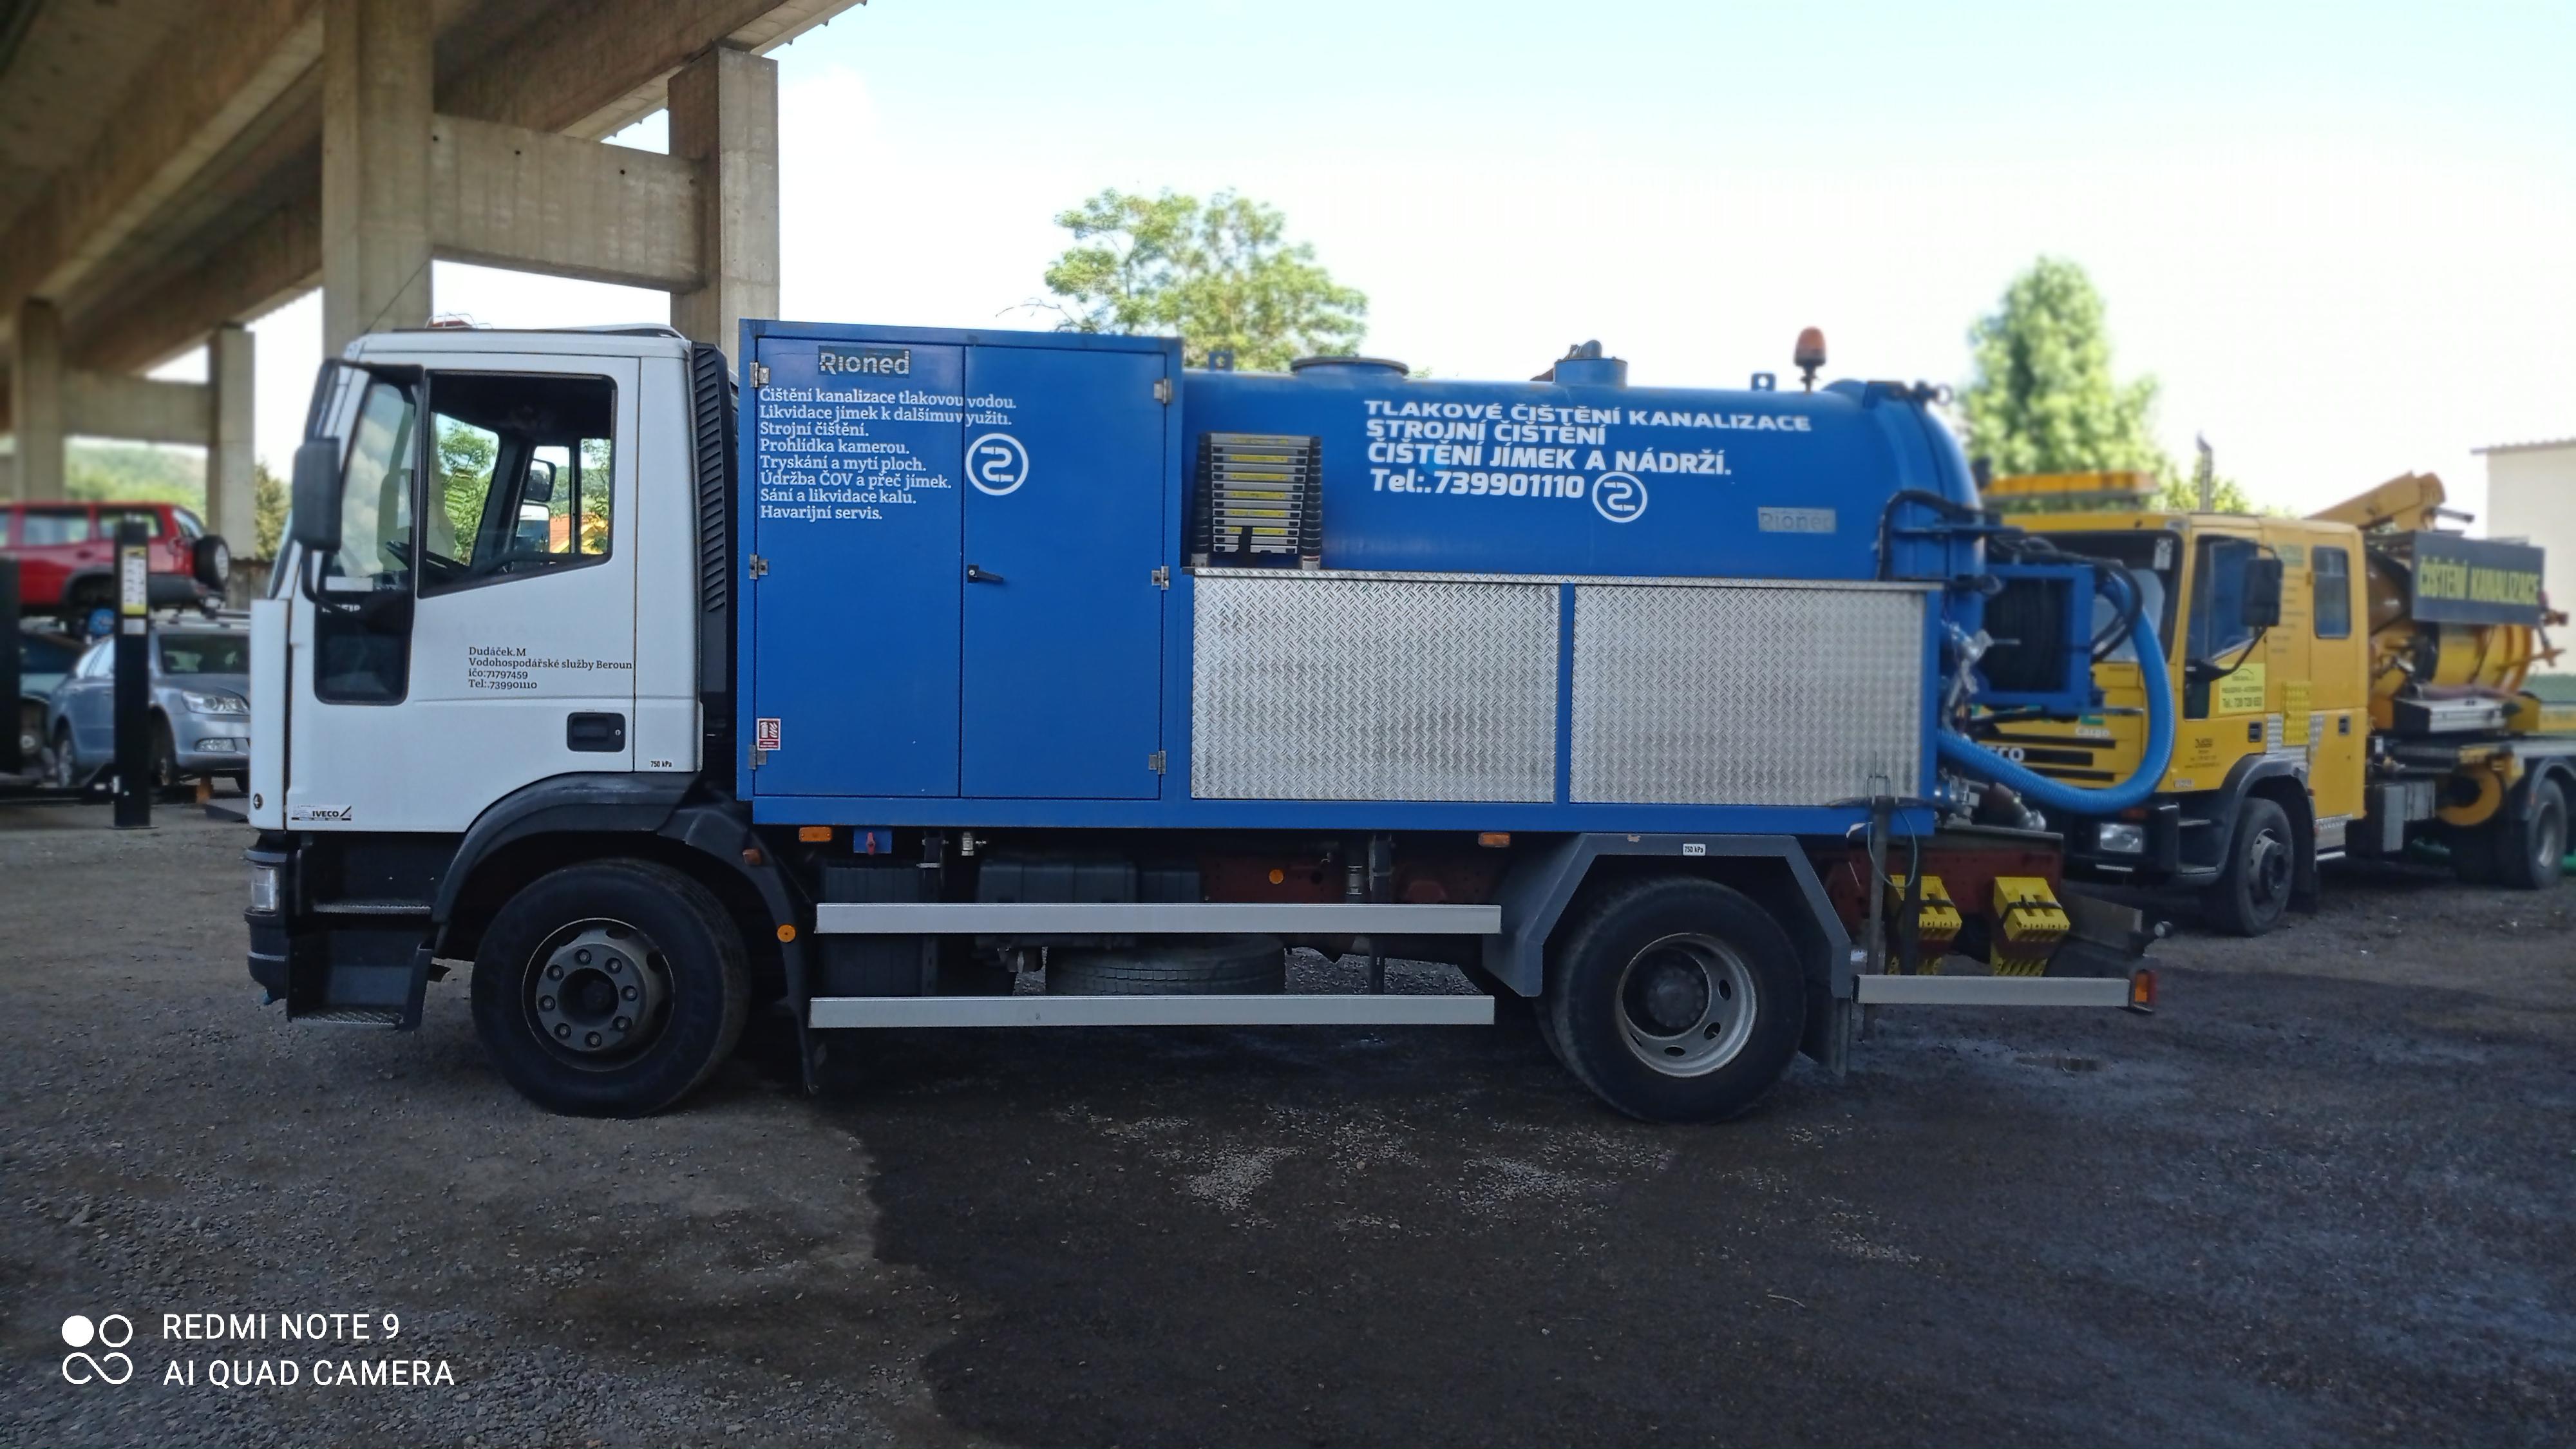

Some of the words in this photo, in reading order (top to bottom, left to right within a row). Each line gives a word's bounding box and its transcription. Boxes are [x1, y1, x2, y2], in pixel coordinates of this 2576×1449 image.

[819, 350, 909, 375] Rioned
[815, 388, 896, 404] kanalizace
[898, 390, 963, 406] tlakovou
[967, 393, 1017, 408] vodou.
[759, 404, 832, 419] Likvidace
[835, 405, 878, 422] jímek
[880, 406, 891, 420] k
[1364, 400, 1503, 419] TLAKOVÉ
[1510, 403, 1621, 424] ČIŠTĚNÍ
[1629, 410, 1812, 431] KANALIZACE
[760, 422, 811, 438] Strojní
[815, 422, 869, 437] čištění.
[1366, 419, 1488, 441] STROJNÍ
[1494, 420, 1606, 445] ČIŠTĚNÍ
[760, 438, 835, 452] Prohlídka
[838, 439, 910, 454] kamerou.
[760, 455, 828, 472] Tryskání
[831, 460, 840, 469] a
[843, 456, 878, 473] mytí
[881, 457, 927, 473] ploch.
[1367, 437, 1484, 466] ČIŠTĚNÍ
[1489, 442, 1577, 469] JÍMEK
[1584, 450, 1607, 470] A
[1615, 447, 1732, 475] NÁDRŽÍ.
[760, 468, 816, 485] Údržba
[819, 470, 853, 486] ČOV
[856, 477, 865, 486] a
[868, 473, 901, 490] přeč
[904, 474, 952, 491] jímek.
[760, 488, 793, 502] Sání
[797, 492, 805, 502] a
[809, 488, 877, 503] likvidace
[879, 489, 916, 504] kalu.
[760, 505, 832, 522] Havarijní
[835, 506, 883, 520] servis.
[2470, 567, 2540, 605] KANALIZACE
[469, 657, 559, 669] Vodohospodářské
[561, 659, 594, 670] služby
[596, 660, 632, 669] Beroun
